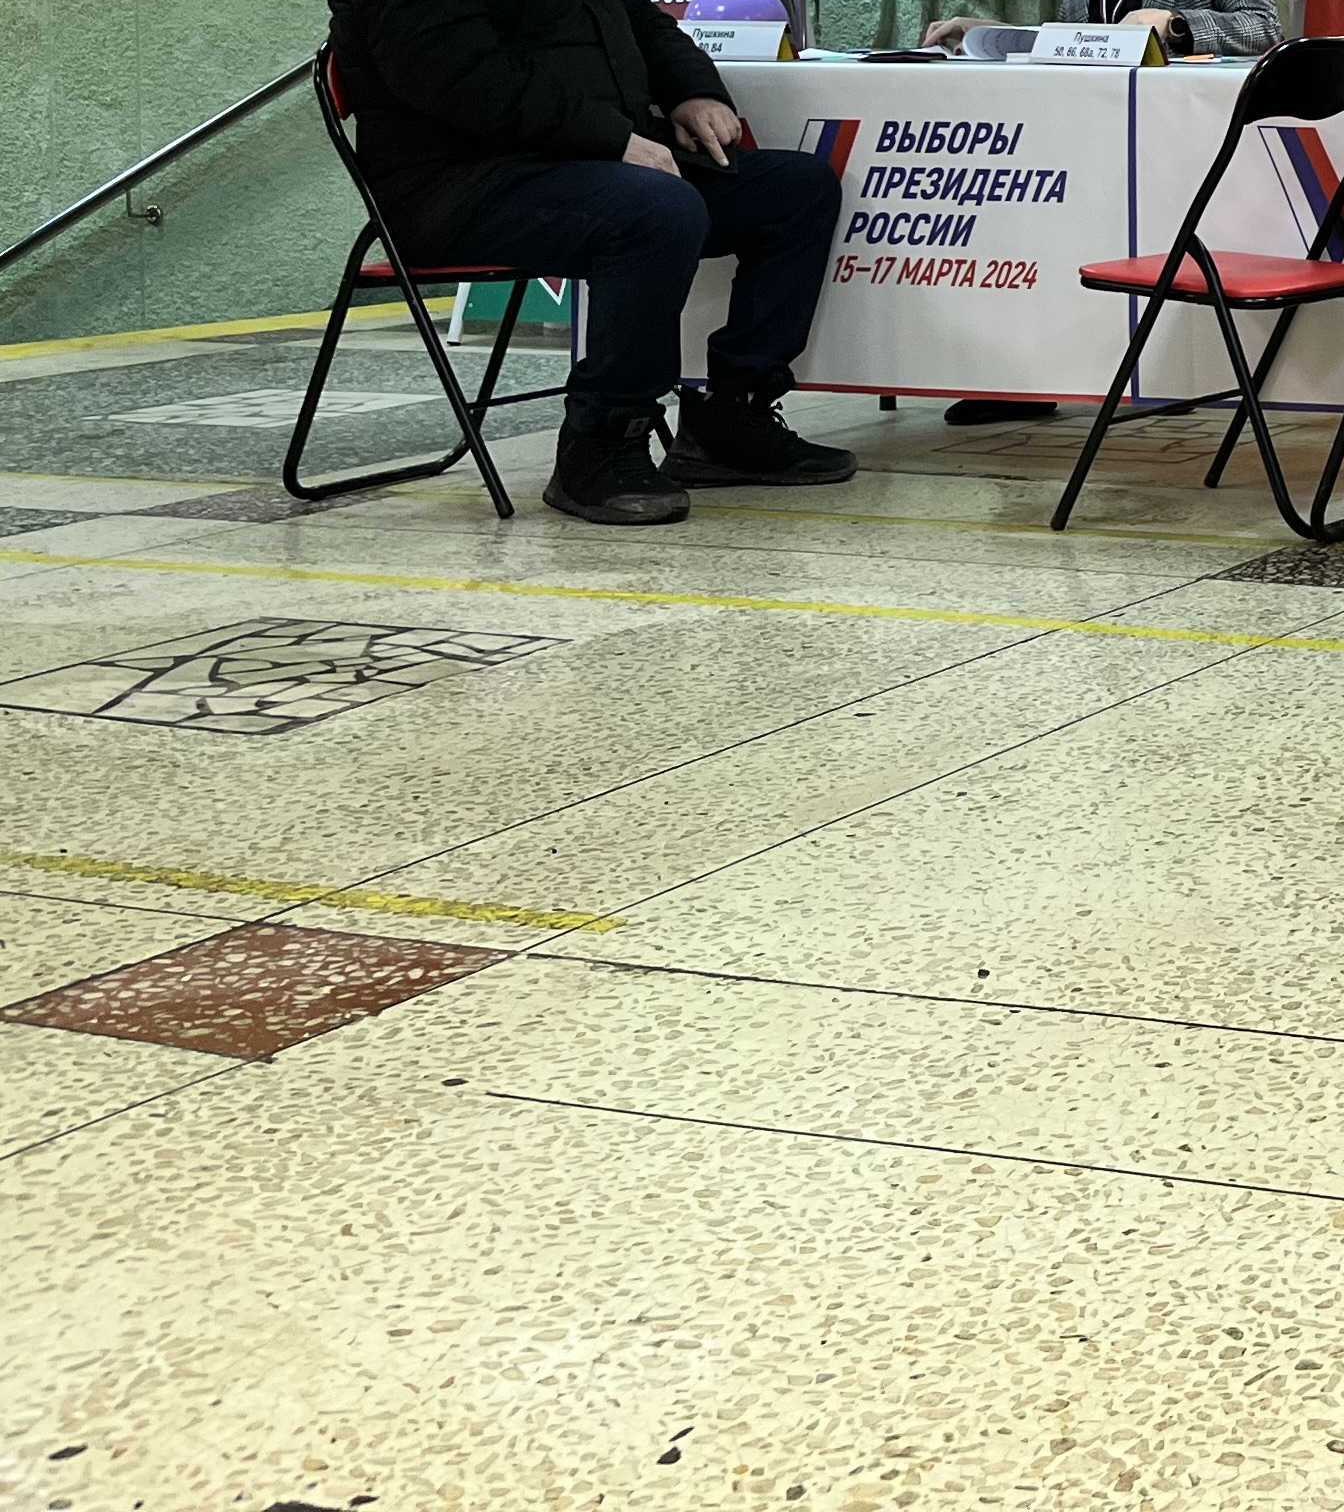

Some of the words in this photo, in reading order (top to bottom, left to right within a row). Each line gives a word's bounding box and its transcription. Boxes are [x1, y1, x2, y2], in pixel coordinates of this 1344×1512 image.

[692, 28, 736, 40] Пушкина
[1073, 31, 1110, 45] Пушкина
[875, 120, 1025, 155] ВЫБОРЫ
[860, 165, 1068, 206] ПРЕЗИДЕНТА
[844, 211, 977, 247] РОССИИ
[897, 257, 977, 288] МАРТА
[979, 259, 1039, 290] 2024
